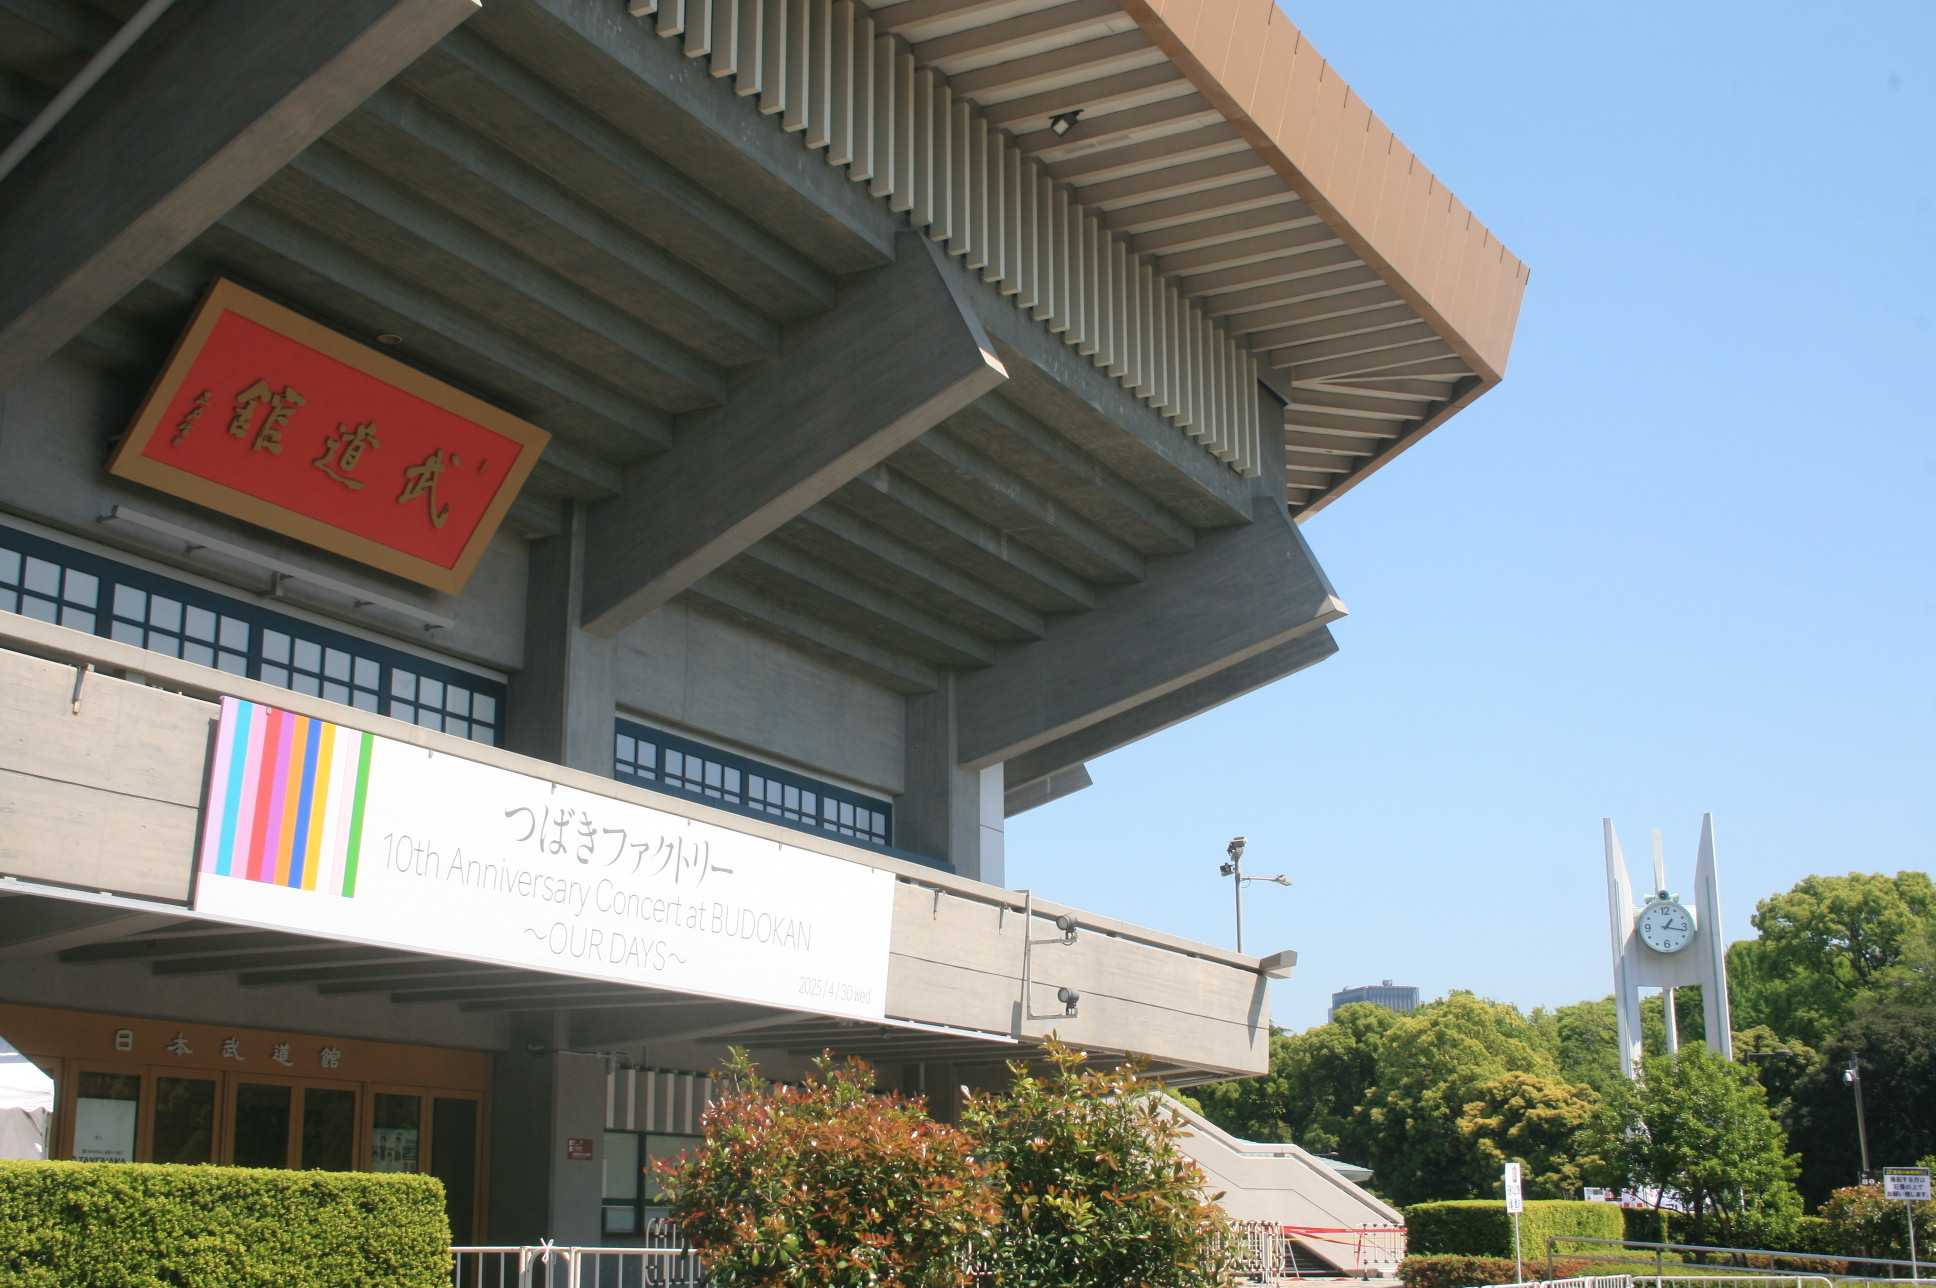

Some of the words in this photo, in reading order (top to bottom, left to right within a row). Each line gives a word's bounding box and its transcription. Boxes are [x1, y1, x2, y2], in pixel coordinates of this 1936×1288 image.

[504, 804, 734, 888] つばきファクトリー
[384, 833, 440, 879] 10th
[447, 847, 592, 917] Anniversary
[596, 878, 682, 928] Concert
[686, 901, 707, 932] at
[711, 902, 813, 952] BUDOKAN
[1661, 906, 1670, 916] 12
[115, 1028, 341, 1068] 日本武道館
